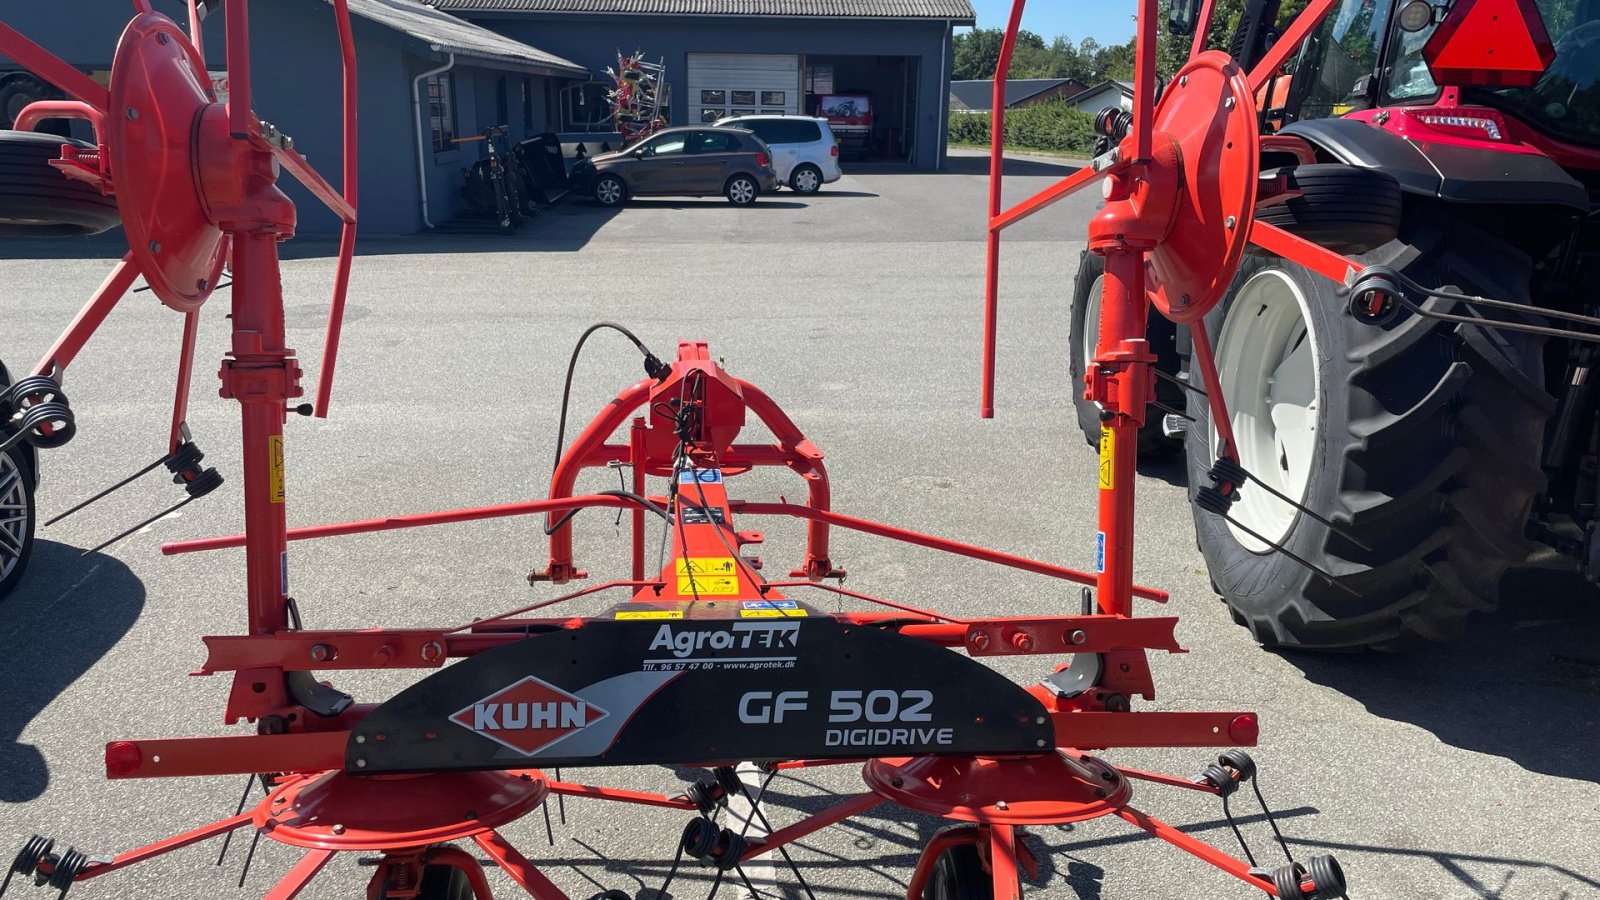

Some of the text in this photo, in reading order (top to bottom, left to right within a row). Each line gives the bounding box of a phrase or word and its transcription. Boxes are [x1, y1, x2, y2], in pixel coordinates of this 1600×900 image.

[648, 621, 801, 658] AgroTEK
[660, 663, 672, 671] 96
[723, 661, 796, 670] www.agrotek.dk
[473, 701, 587, 731] KUHN
[738, 689, 934, 724] GF 502
[825, 728, 953, 746] DIGIDRIVE
